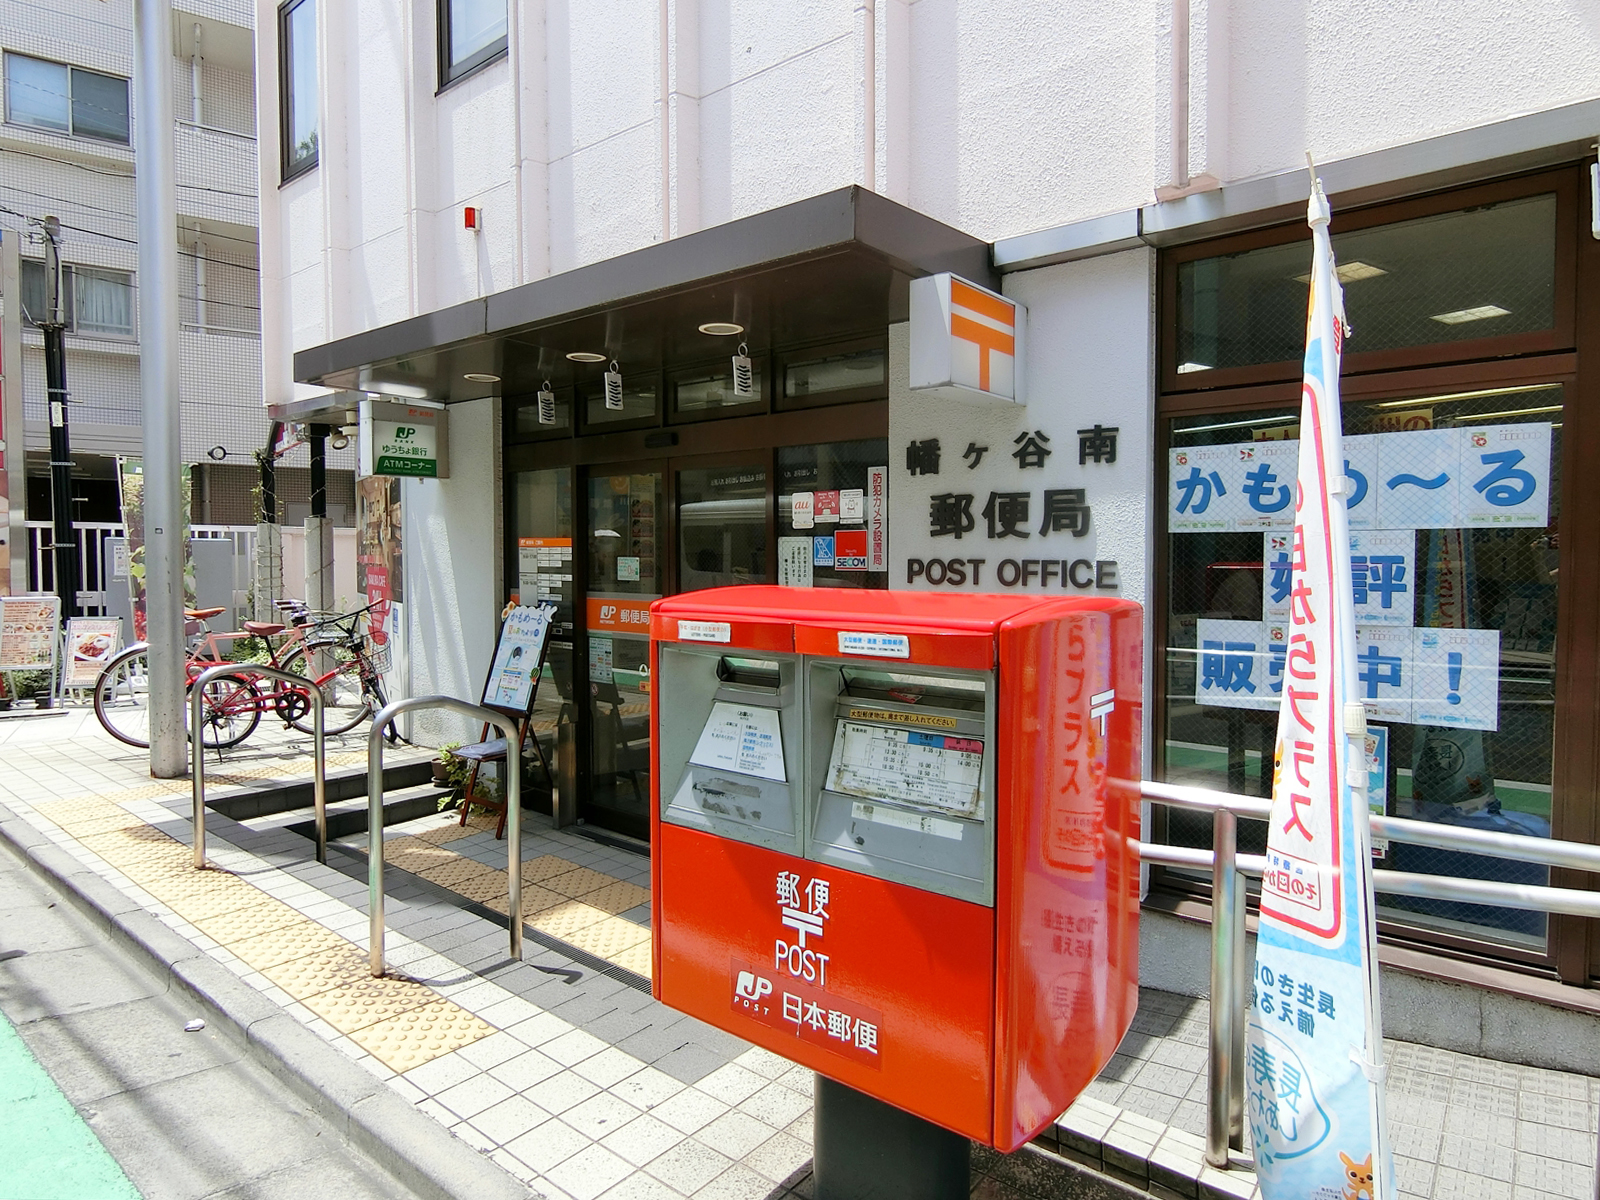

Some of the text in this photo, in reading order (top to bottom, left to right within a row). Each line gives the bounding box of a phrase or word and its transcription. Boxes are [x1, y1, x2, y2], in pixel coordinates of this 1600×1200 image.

[382, 445, 427, 456] ゆうちょ銀行
[384, 460, 432, 469] ATMコーナー
[795, 501, 810, 510] au
[928, 488, 1091, 540] 郵便局
[873, 472, 882, 566] 防犯カメラ設置局
[837, 558, 866, 567] SECOM
[907, 558, 1118, 589] POST OFFICE
[620, 609, 650, 625] 郵便局
[776, 870, 830, 920] 郵便
[775, 938, 830, 986] POST
[734, 995, 770, 1016] POST
[782, 991, 878, 1055] 日本郵便
